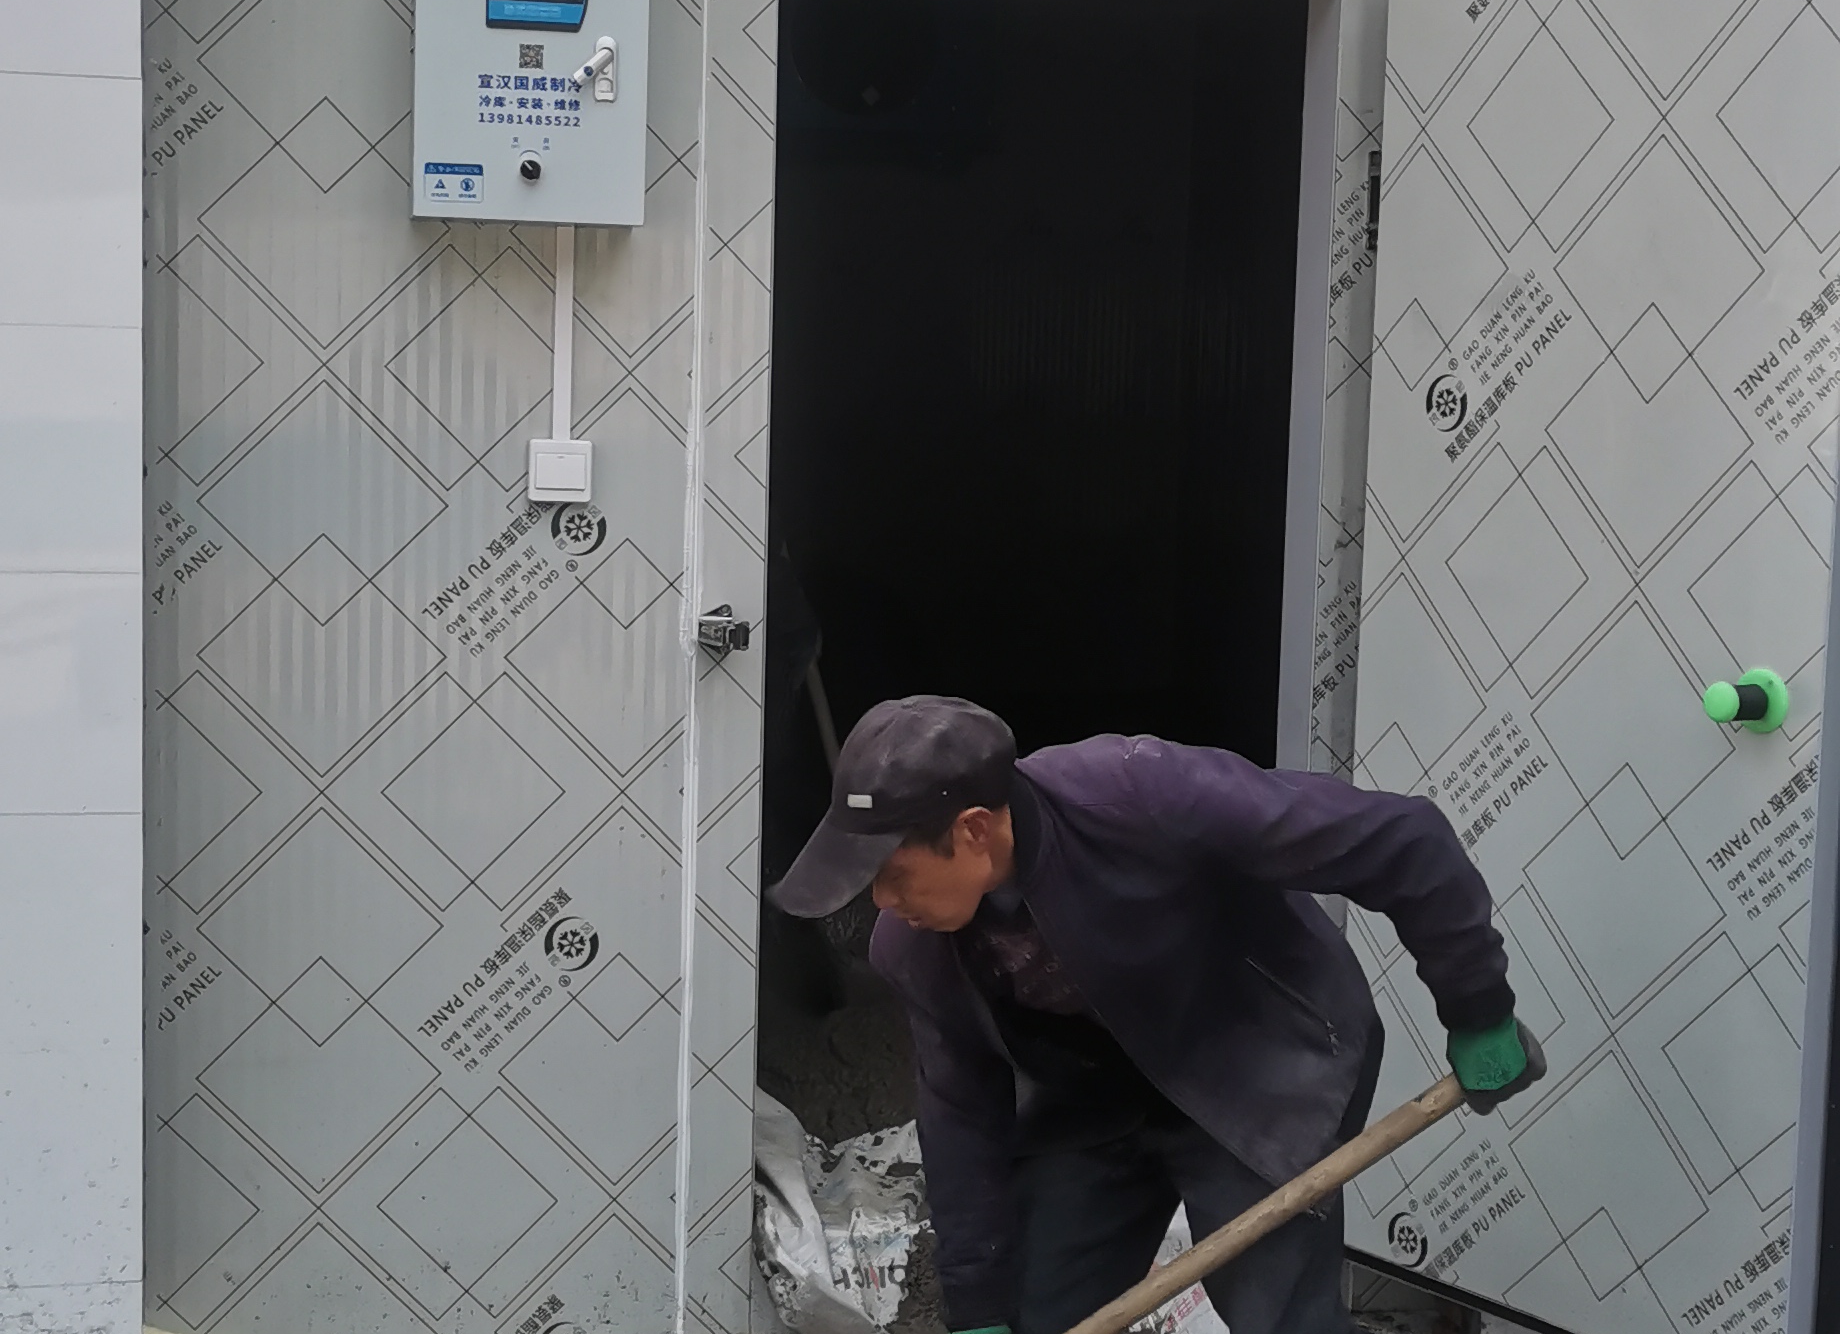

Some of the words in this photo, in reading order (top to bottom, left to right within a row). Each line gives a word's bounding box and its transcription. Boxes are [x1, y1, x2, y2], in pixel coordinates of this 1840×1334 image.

[158, 58, 172, 74] KU
[165, 72, 185, 91] PAI
[176, 84, 198, 105] BAO
[478, 113, 580, 127] 13981485522
[151, 141, 176, 166] PU
[173, 100, 224, 145] PANEL
[1337, 191, 1360, 215] LENG
[1347, 208, 1364, 227] PIN
[1352, 252, 1373, 276] PU
[1463, 339, 1479, 361] GAO
[1479, 311, 1502, 340] DUAN
[1502, 285, 1523, 311] LENG
[1523, 268, 1536, 285] KU
[1470, 346, 1492, 374] FANG
[1493, 324, 1510, 344] XIN
[1511, 303, 1527, 323] PIN
[1528, 282, 1544, 302] PAI
[1491, 344, 1513, 370] NENG
[1513, 316, 1535, 344] HUAN
[1535, 293, 1553, 315] BAO
[1779, 326, 1801, 356] PU
[1803, 334, 1831, 365] NENG
[1445, 371, 1520, 463] 聚氨酯保温库板
[1515, 350, 1534, 376] PU
[1532, 309, 1572, 356] PANEL
[1733, 351, 1780, 400] PANEL
[1775, 365, 1803, 395] HUAN
[1807, 364, 1826, 385] XIN
[1754, 394, 1775, 417] BAO
[1786, 387, 1805, 409] PIN
[1765, 410, 1784, 431] PAI
[1790, 400, 1816, 429] LENG
[1774, 428, 1790, 445] KU
[157, 500, 173, 517] KU
[165, 513, 185, 532] PAI
[176, 524, 197, 546] BAO
[174, 539, 223, 584] PANEL
[468, 556, 491, 579] PU
[495, 560, 522, 587] NENG
[521, 557, 549, 585] FANG
[538, 569, 560, 591] GAO
[421, 576, 470, 620] PANEL
[467, 586, 495, 614] HUAN
[500, 585, 519, 605] XIN
[510, 590, 538, 618] DUAN
[1319, 596, 1342, 619] LENG
[1344, 580, 1357, 595] KU
[446, 613, 467, 634] BAO
[479, 606, 498, 626] PIN
[458, 626, 477, 646] PAI
[485, 617, 510, 643] LENG
[1333, 622, 1357, 648] HUAN
[469, 642, 485, 658] KU
[1335, 654, 1355, 677] PU
[1443, 771, 1458, 790] GAO
[1459, 747, 1480, 772] DUAN
[1480, 725, 1501, 749] LENG
[1501, 711, 1513, 726] KU
[1450, 779, 1471, 804] FANG
[1472, 761, 1488, 779] XIN
[1489, 743, 1505, 761] PIN
[1506, 724, 1521, 743] PAI
[1468, 780, 1491, 805] NENG
[1491, 756, 1513, 782] HUAN
[1514, 738, 1530, 758] BAO
[1493, 789, 1511, 815] PU
[1510, 755, 1548, 796] PANEL
[1750, 809, 1772, 836] PU
[1774, 821, 1800, 847] NENG
[1706, 828, 1751, 873] PANEL
[1747, 846, 1774, 873] HUAN
[1778, 848, 1797, 868] XIN
[1727, 870, 1747, 891] BAO
[1757, 867, 1776, 887] PIN
[1786, 857, 1813, 885] DUAN
[1737, 887, 1755, 906] PAI
[1762, 882, 1787, 908] LENG
[1747, 905, 1762, 921] KU
[480, 887, 573, 978] 聚氨酯保温库板
[166, 941, 185, 959] PAI
[176, 951, 197, 972] BAO
[515, 961, 530, 978] JIE
[173, 966, 222, 1010] PANEL
[462, 973, 485, 998] PU
[489, 977, 516, 1004] NENG
[514, 973, 542, 1001] FANG
[532, 984, 552, 1006] GAO
[417, 994, 464, 1037] PANEL
[462, 1004, 489, 1031] HUAN
[495, 1002, 513, 1022] XIN
[504, 1006, 531, 1034] DUAN
[440, 1031, 461, 1051] BAO
[473, 1023, 492, 1042] PIN
[452, 1043, 471, 1062] PAI
[479, 1033, 504, 1058] LENG
[464, 1057, 479, 1073] KU
[1472, 1216, 1490, 1238] PU
[1488, 1185, 1526, 1223] PANEL
[1723, 1273, 1745, 1298] PU
[1681, 1289, 1725, 1328] PANEL
[1747, 1289, 1774, 1314] NENG
[1720, 1309, 1747, 1334] HUAN
[1751, 1316, 1771, 1334] XIN
